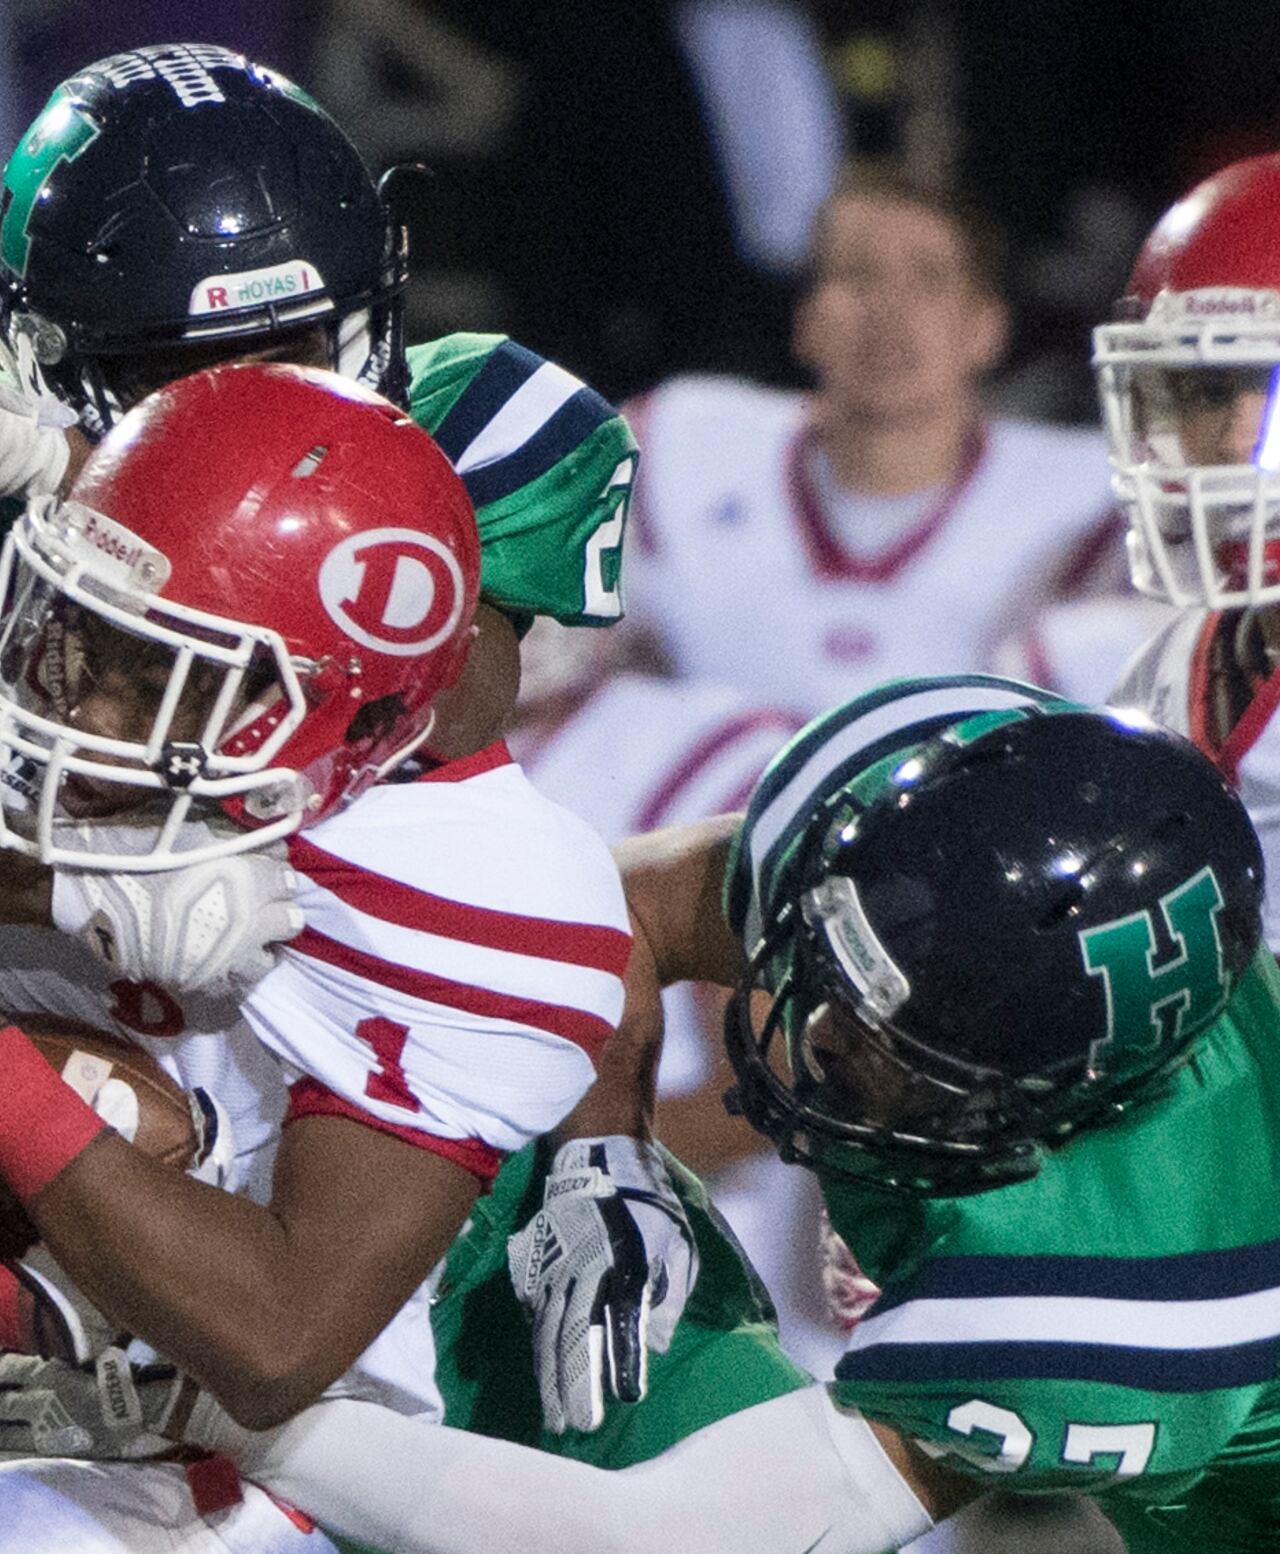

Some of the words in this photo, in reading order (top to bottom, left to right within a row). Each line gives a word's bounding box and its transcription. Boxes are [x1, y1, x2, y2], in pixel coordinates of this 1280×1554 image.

[206, 286, 229, 309] R
[238, 274, 296, 301] HOYAS
[338, 540, 456, 644] D
[1078, 865, 1231, 1076] H
[354, 1015, 421, 1114] 1
[526, 1213, 546, 1291] adidas
